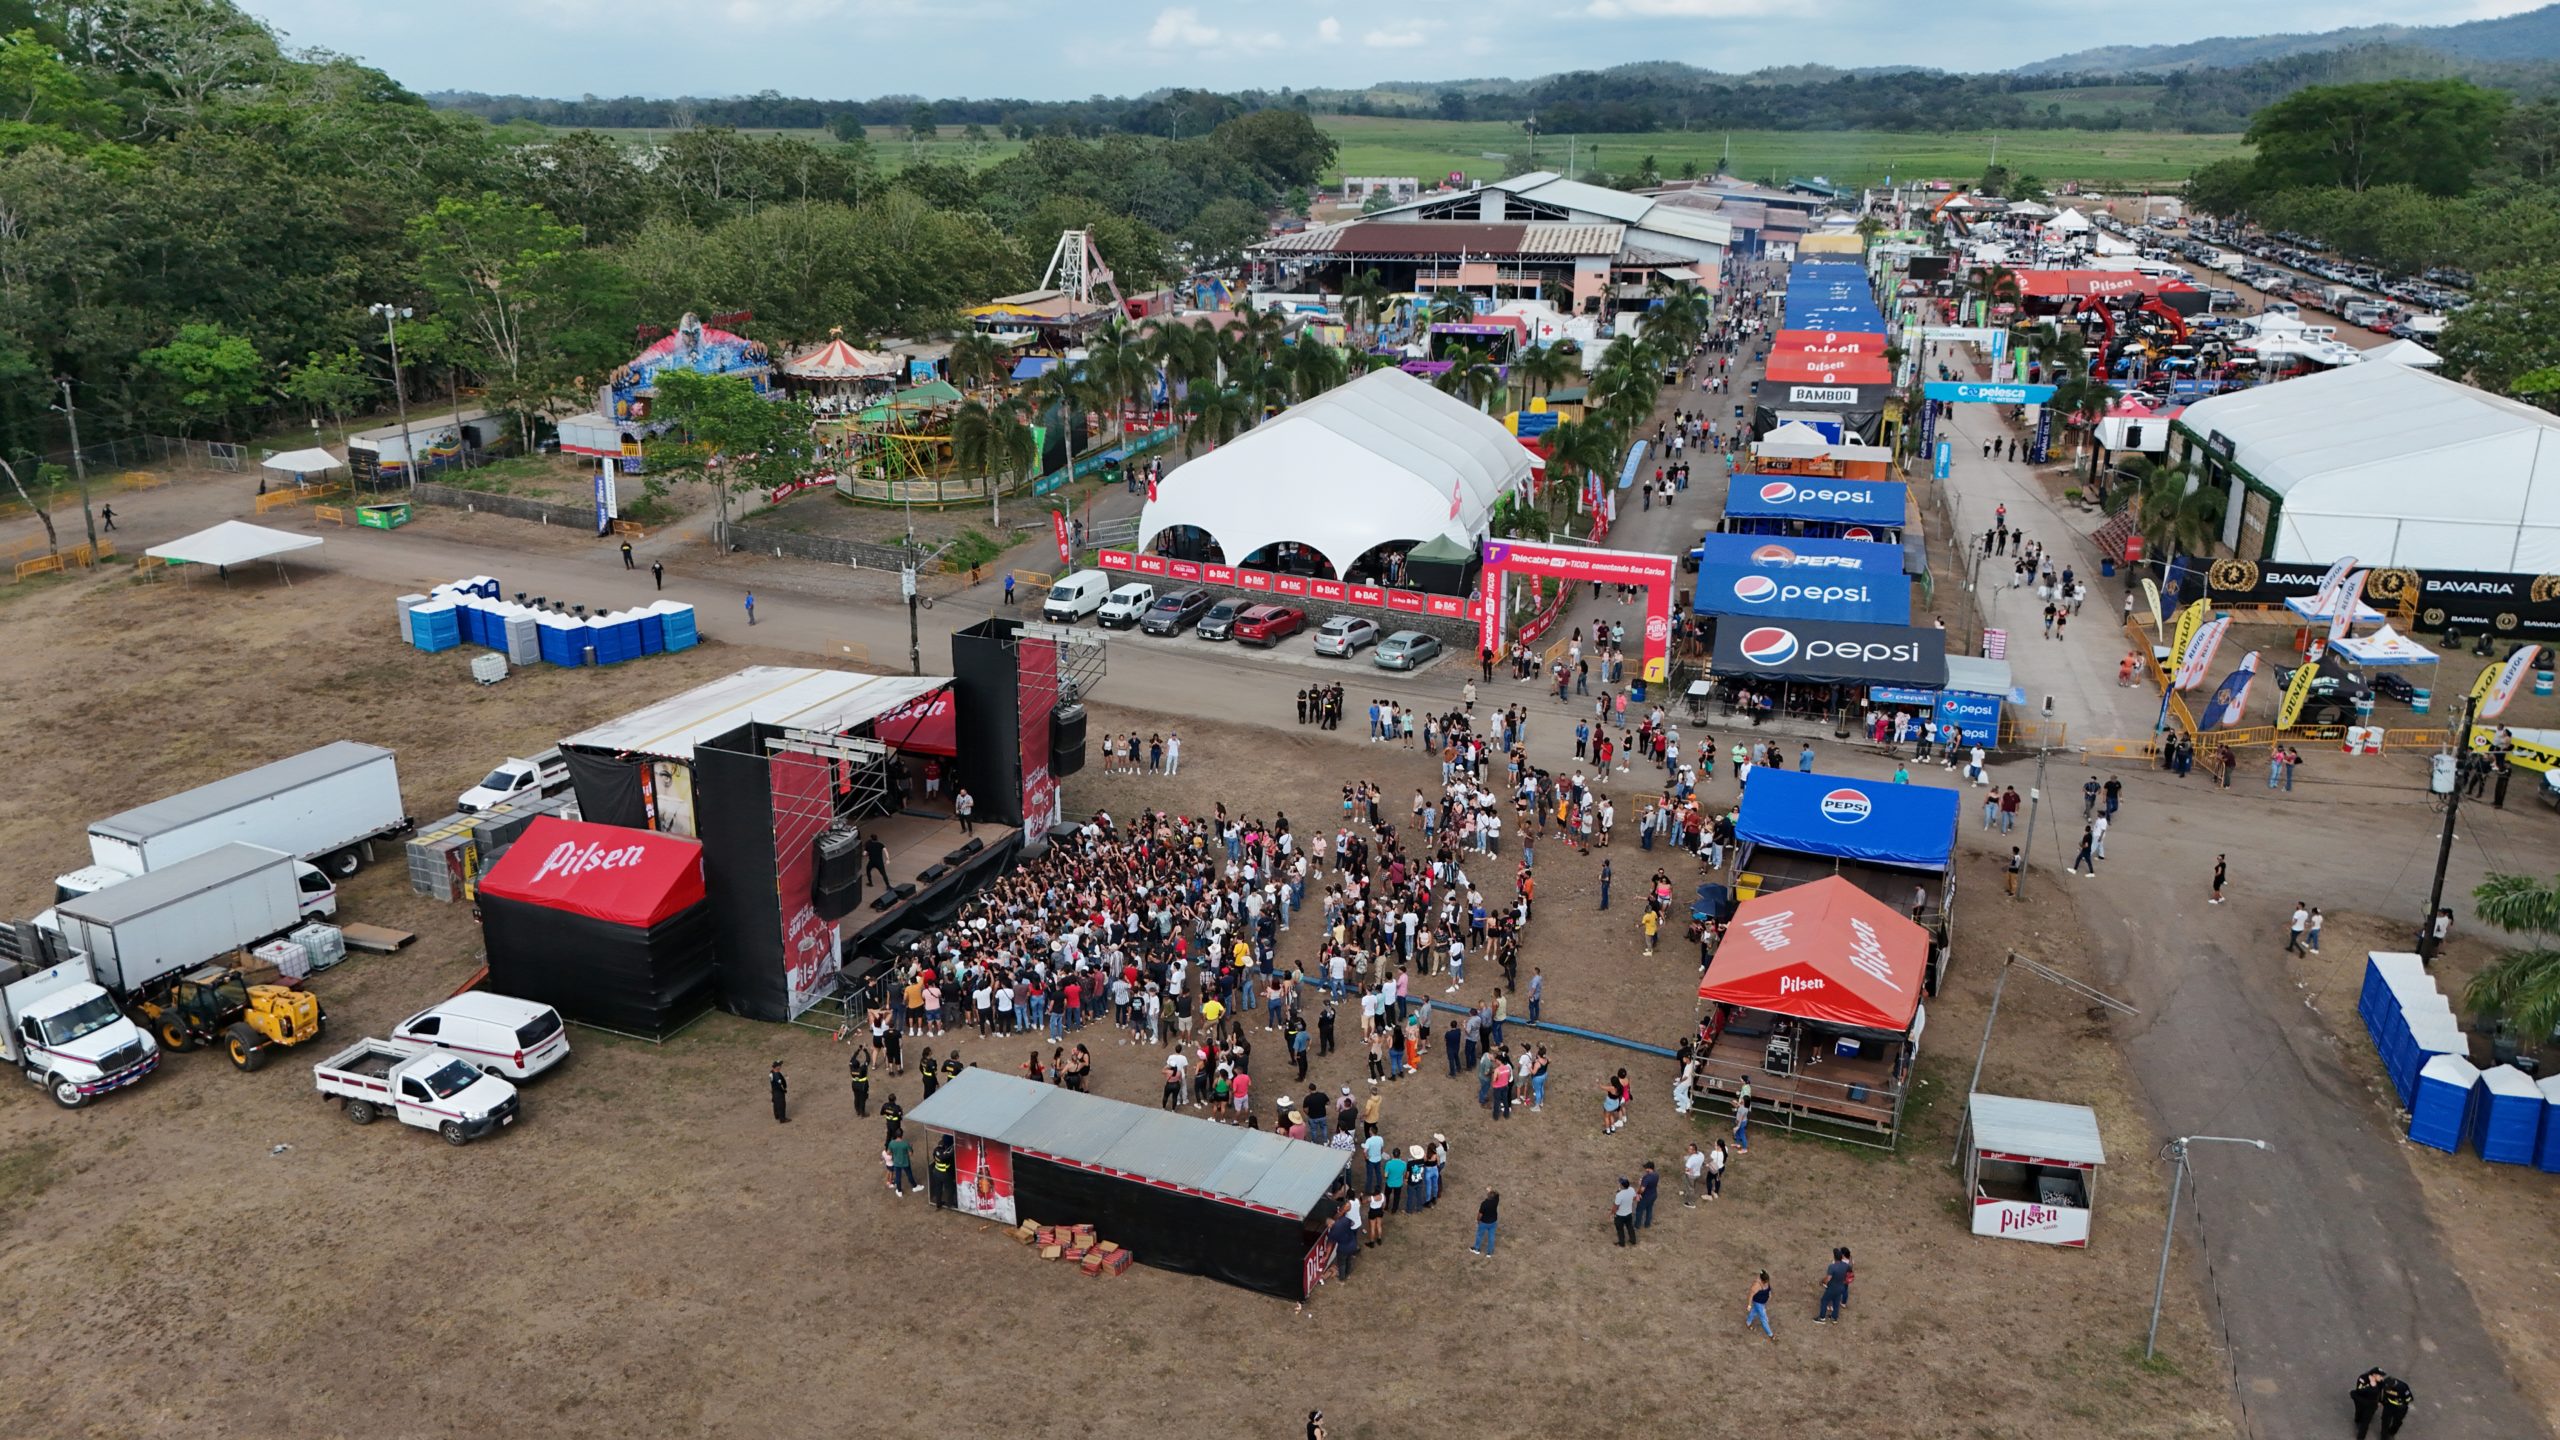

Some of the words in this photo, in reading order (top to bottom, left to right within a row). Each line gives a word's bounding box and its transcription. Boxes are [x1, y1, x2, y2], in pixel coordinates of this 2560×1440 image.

[2089, 279, 2133, 293] Pilsen
[1796, 388, 1851, 401] BAMBOO
[1798, 490, 1871, 504] pepsi
[1112, 556, 1127, 565] BAC
[1511, 553, 1550, 566] Telecable
[1629, 566, 1643, 574] San
[1644, 567, 1666, 576] Carlos
[1794, 555, 1862, 569] PEPSI
[1216, 570, 1230, 579] BAC
[1324, 585, 1340, 595] BAC
[1781, 585, 1867, 604] pepsi
[2426, 580, 2514, 595] BAVARIA
[1363, 591, 1378, 601] BAC
[2451, 615, 2489, 624] BAVARIA
[1805, 640, 1919, 663] pepsi
[1650, 666, 1660, 678] T
[2502, 656, 2524, 686] REPSOL
[2286, 666, 2310, 717] DUNLOP
[2475, 667, 2497, 702] NLOP
[1960, 705, 1993, 716] pepsi
[1962, 727, 1989, 739] epsi
[1824, 800, 1869, 814] PEPSI
[530, 841, 642, 884] Pilsen
[1742, 910, 1795, 951] Pilsen
[1848, 917, 1903, 993] Pilsen
[1780, 975, 1824, 995] Pilsen
[2000, 1207, 2058, 1233] Pilsen
